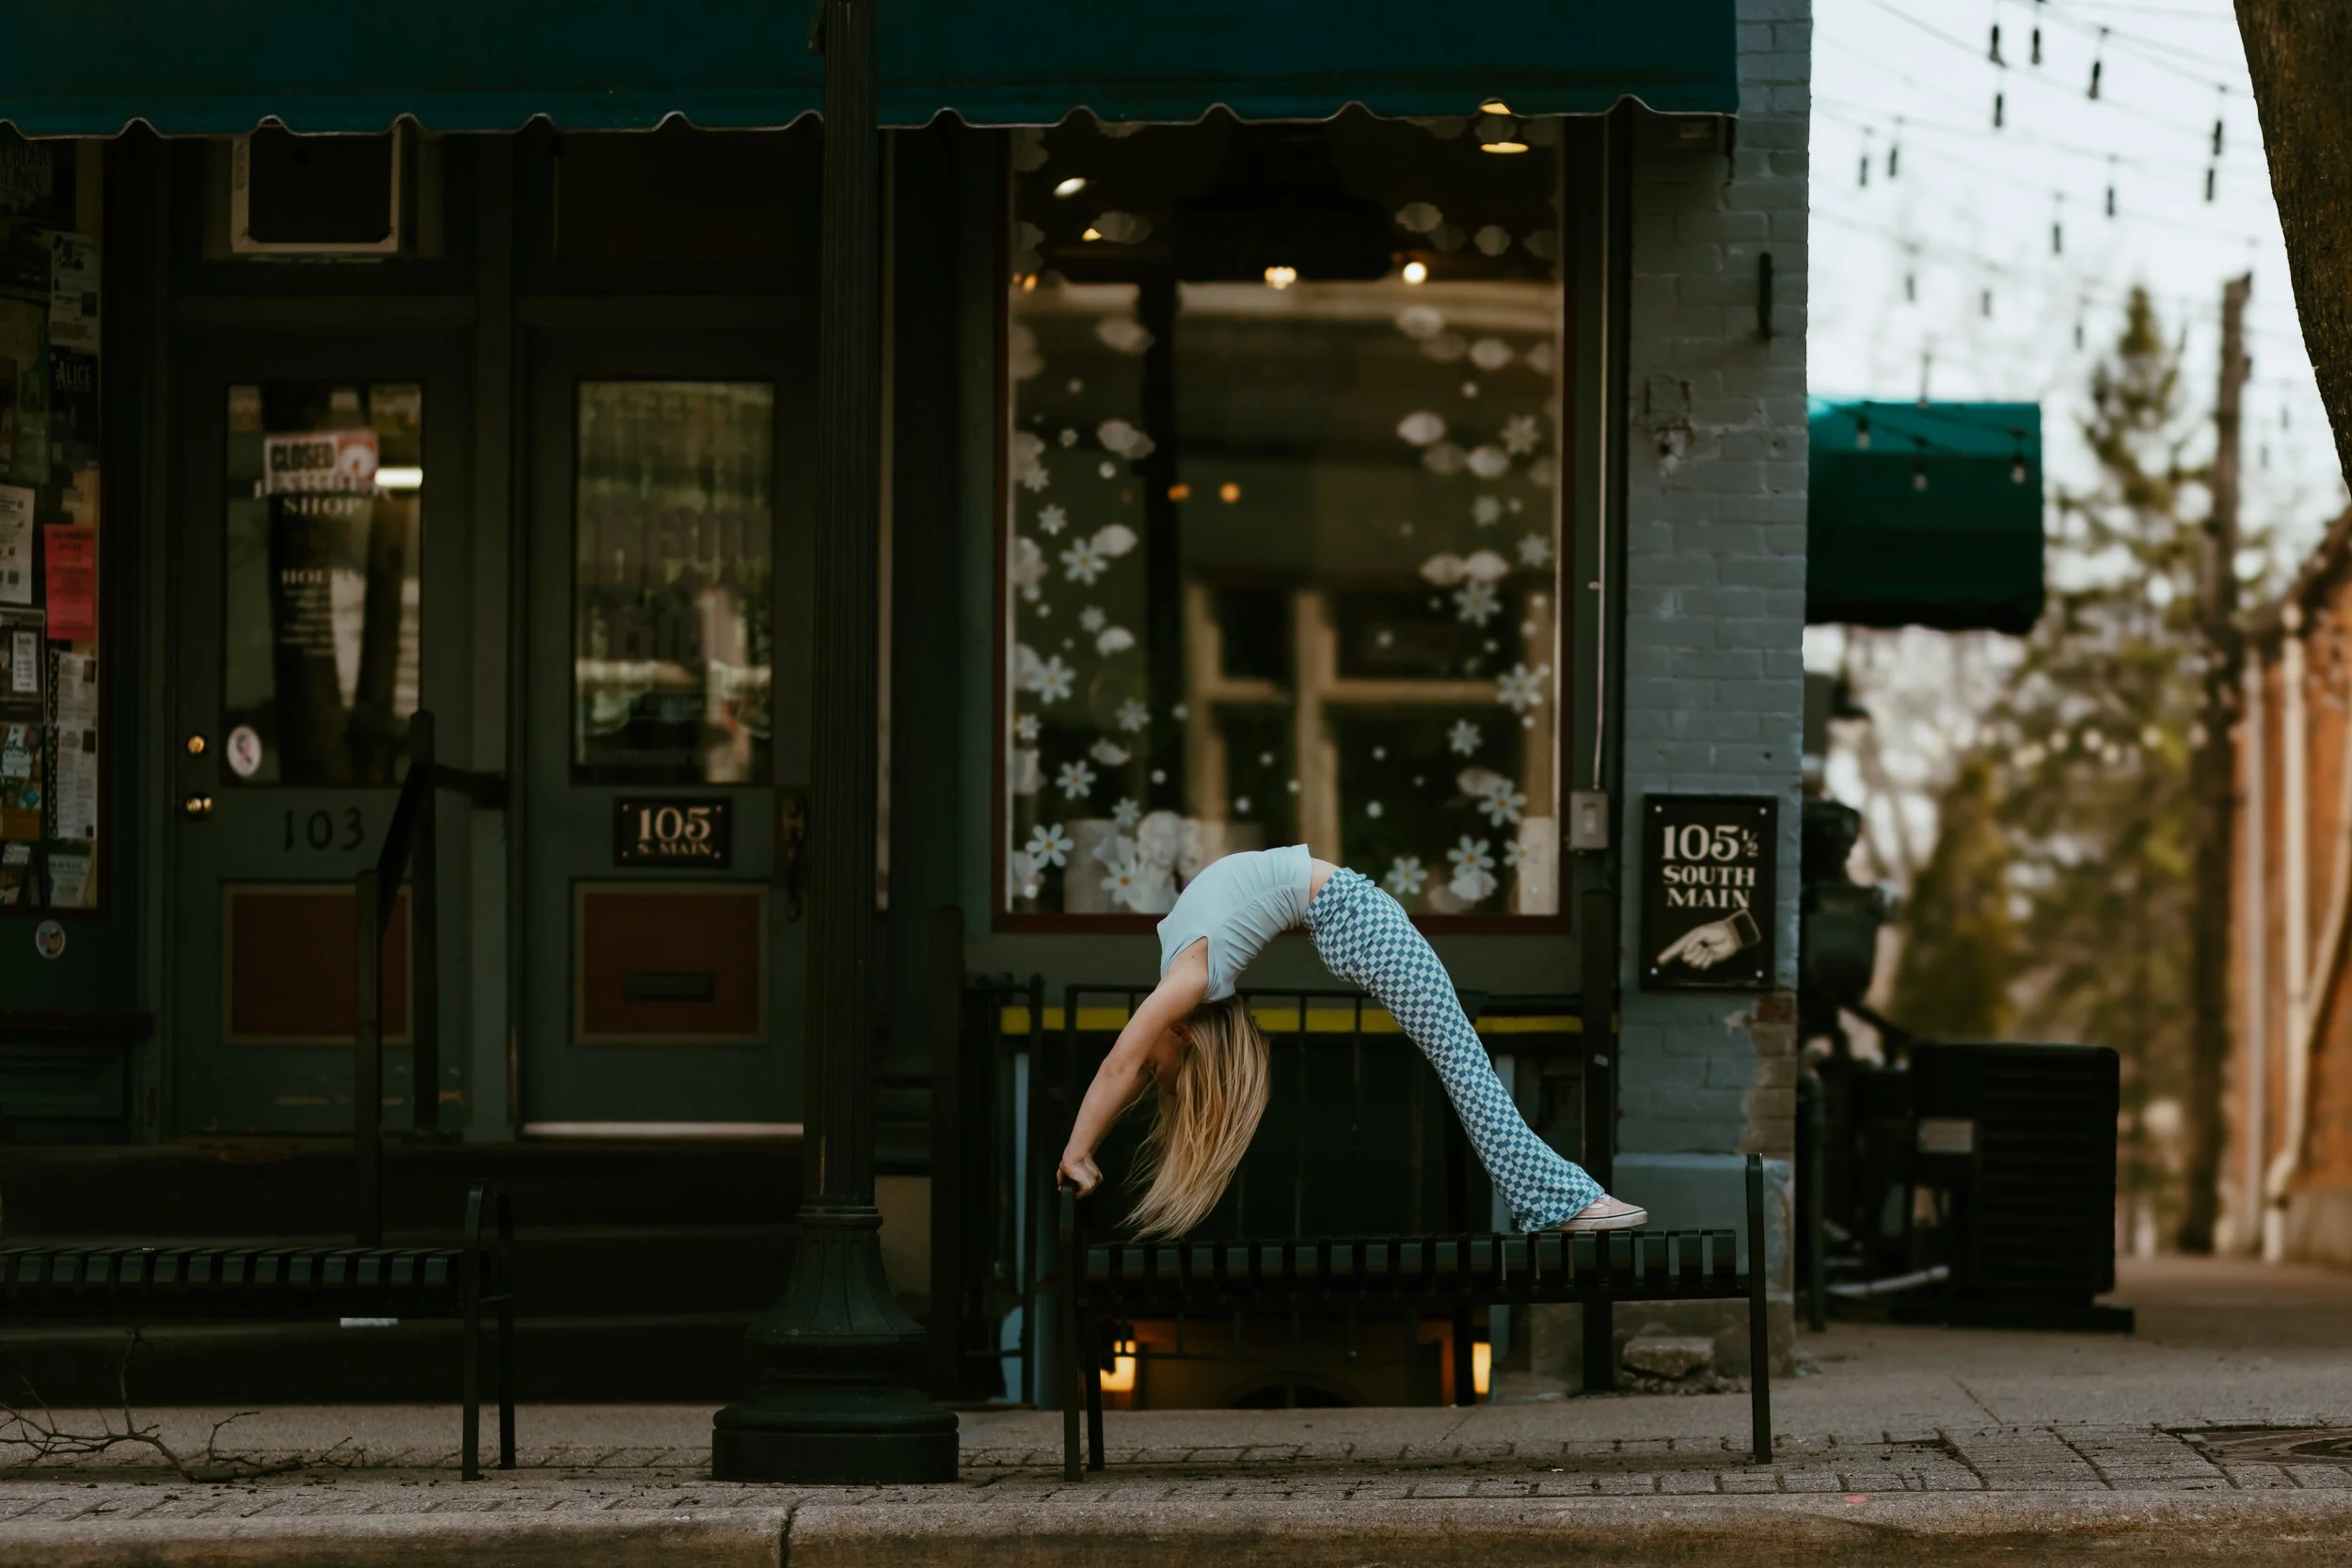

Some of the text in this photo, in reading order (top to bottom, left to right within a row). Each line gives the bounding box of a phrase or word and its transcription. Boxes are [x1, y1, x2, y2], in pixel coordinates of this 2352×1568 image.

[56, 359, 91, 390] ALICE
[270, 442, 336, 473] CLOSED
[283, 497, 363, 518] SHOP
[283, 805, 365, 853] 103
[639, 805, 712, 841] 105
[659, 841, 712, 856] MAIN
[1661, 864, 1757, 887] SOUTH
[1666, 887, 1753, 909] MAIN
